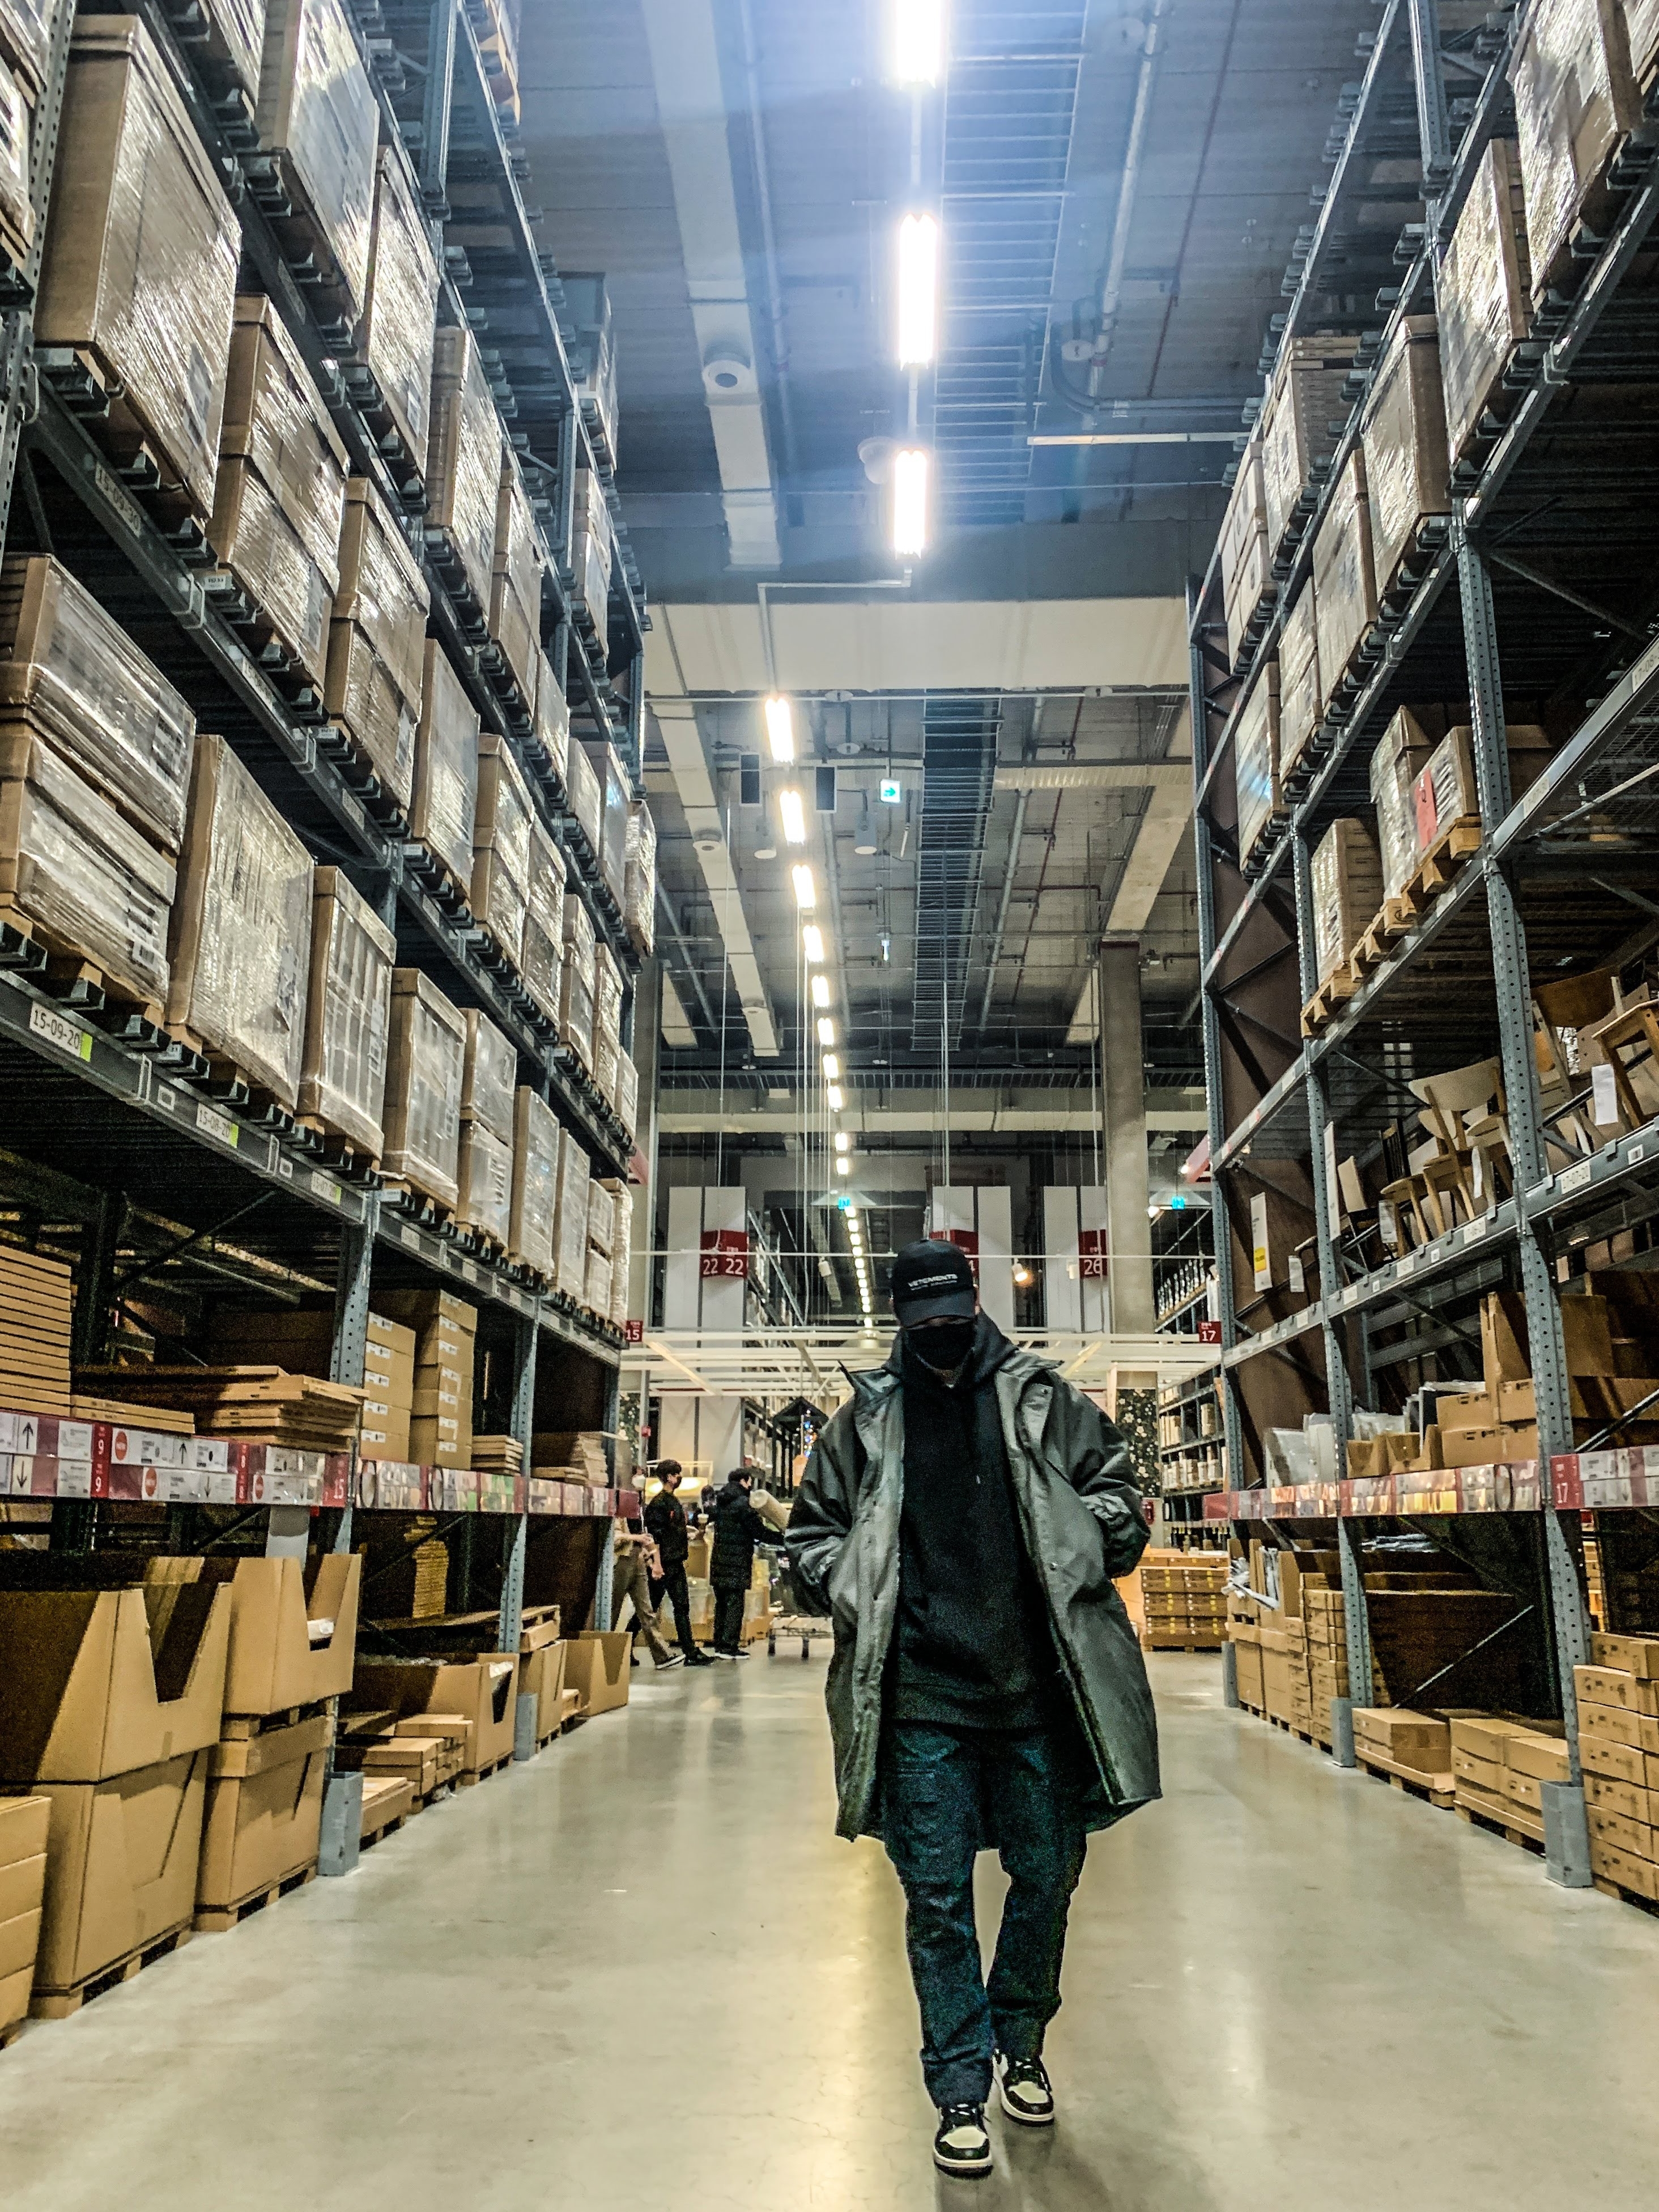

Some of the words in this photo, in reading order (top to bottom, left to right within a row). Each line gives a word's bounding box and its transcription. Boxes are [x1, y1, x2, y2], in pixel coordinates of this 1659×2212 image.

[34, 1010, 79, 1049] 15-09-20
[703, 1258, 718, 1275] 22
[725, 1257, 743, 1275] 22
[1084, 1258, 1102, 1275] 26
[626, 1329, 640, 1341] 15
[1202, 1330, 1216, 1342] 17
[98, 1439, 105, 1455] 9
[95, 1476, 101, 1492] 9
[333, 1478, 344, 1500] 15
[1556, 1482, 1568, 1504] 17
